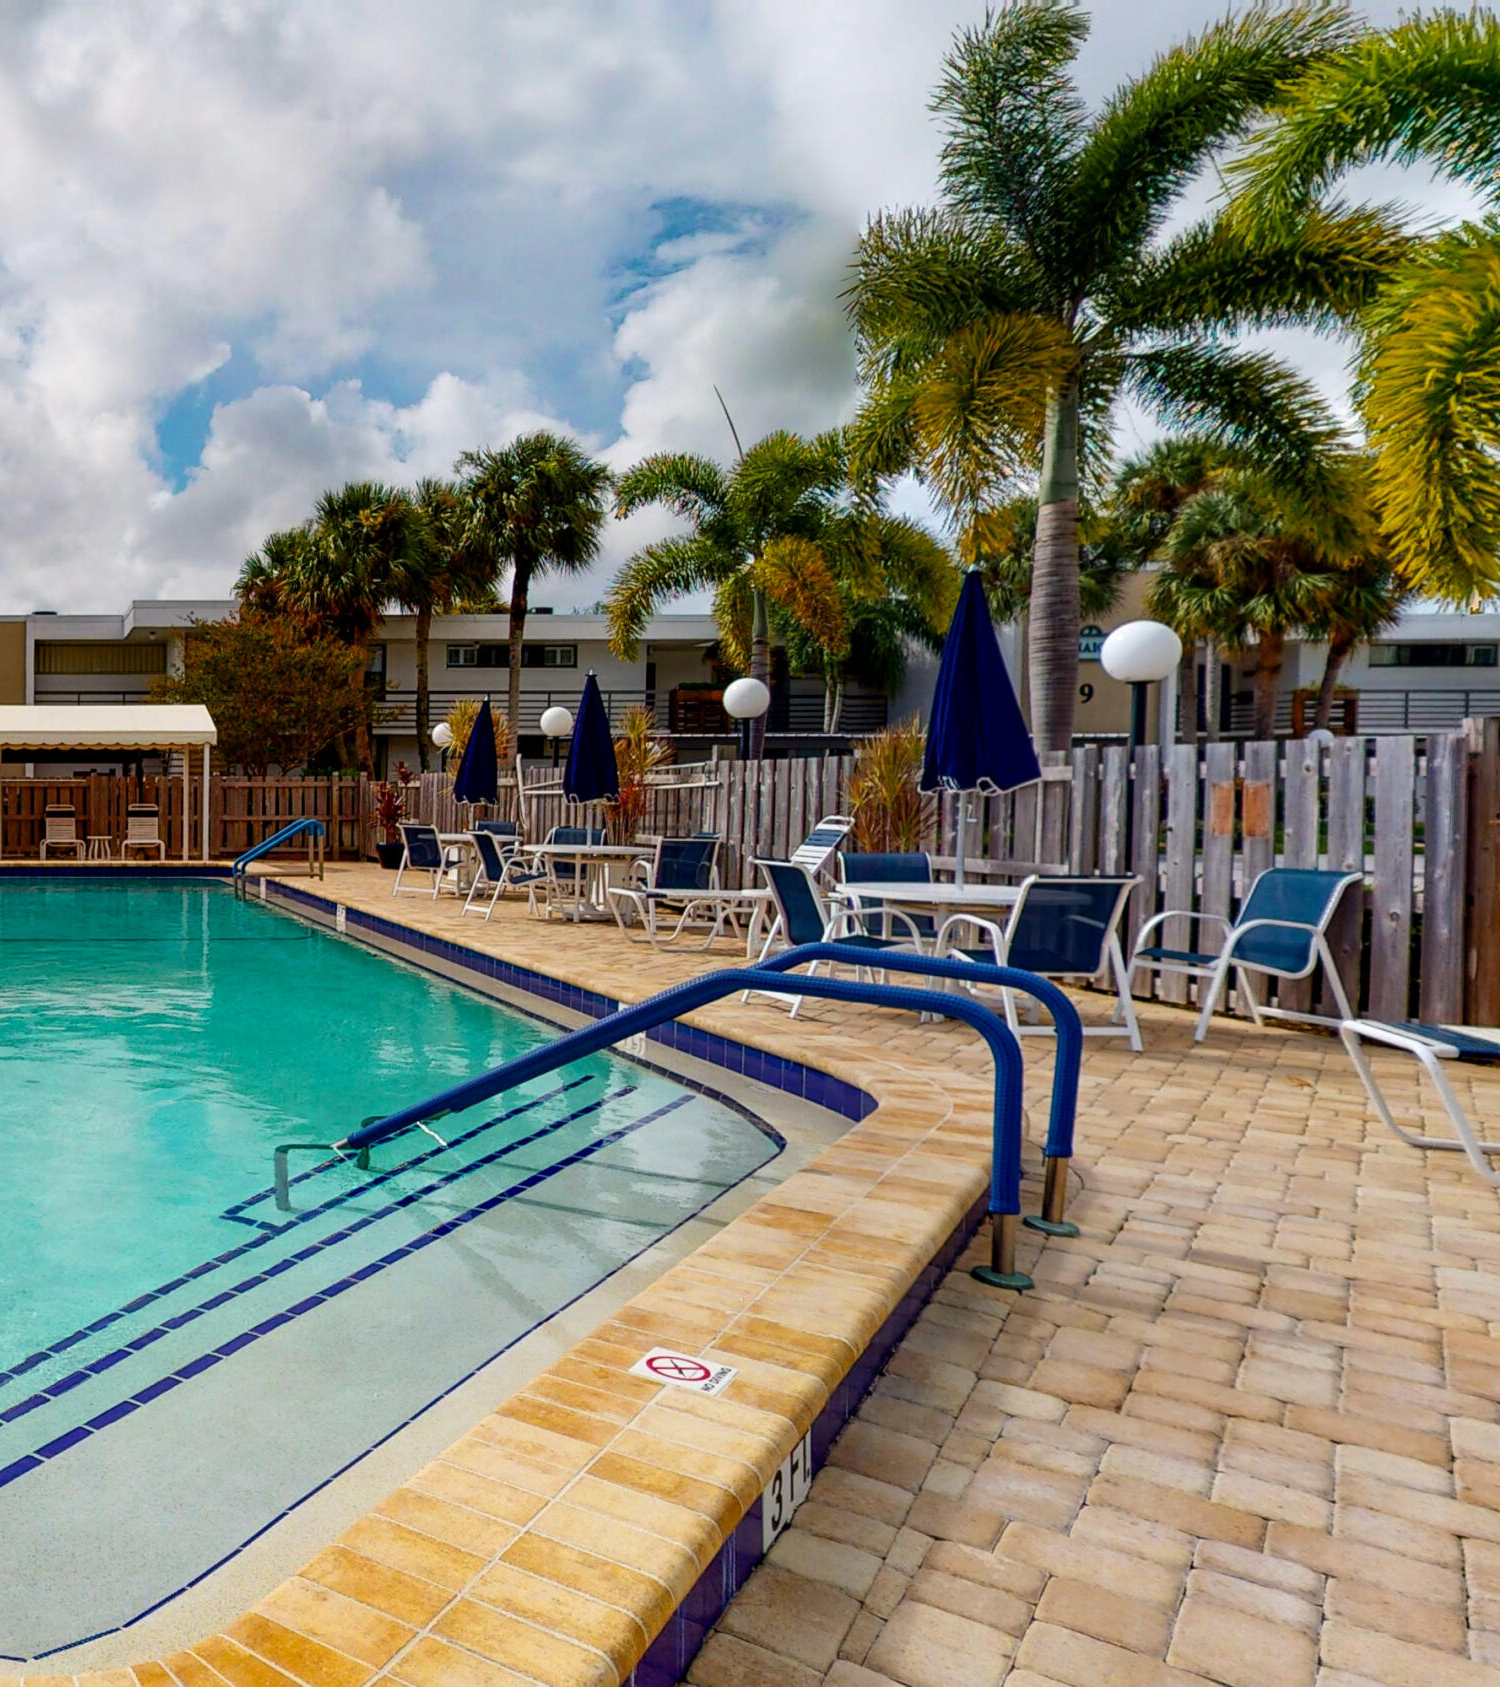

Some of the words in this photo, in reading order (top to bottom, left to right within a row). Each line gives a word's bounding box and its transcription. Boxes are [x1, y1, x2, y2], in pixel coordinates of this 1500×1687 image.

[1079, 683, 1094, 704] 9
[700, 1383, 715, 1392] NO
[709, 1367, 732, 1385] DIVING
[771, 1469, 783, 1532] 3
